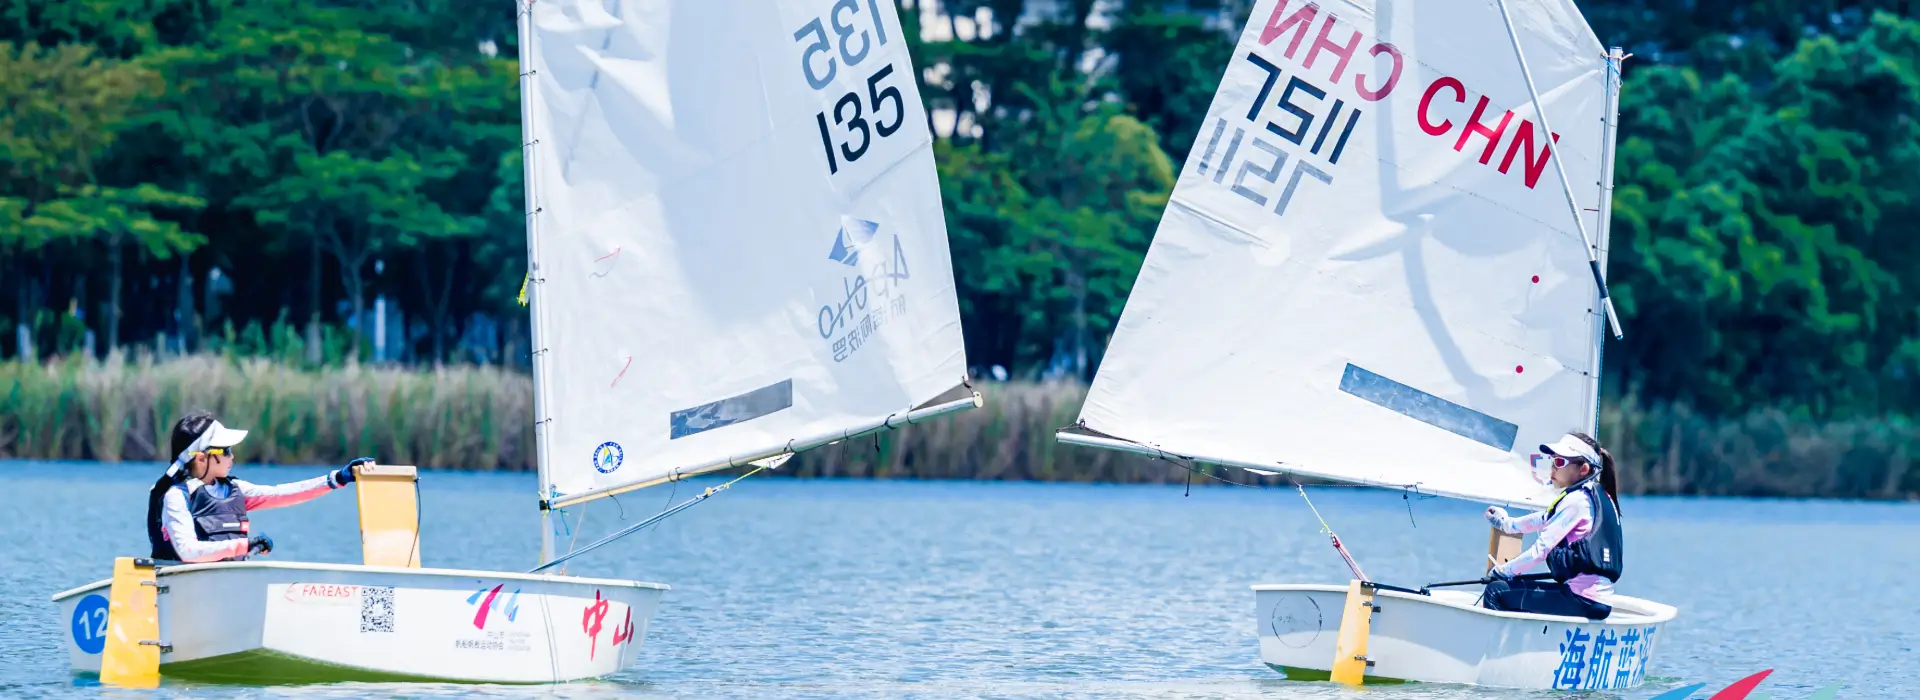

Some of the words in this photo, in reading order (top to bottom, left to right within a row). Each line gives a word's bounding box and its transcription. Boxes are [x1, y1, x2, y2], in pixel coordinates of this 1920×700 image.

[816, 63, 904, 176] 135
[1246, 51, 1362, 165] 7511
[1417, 76, 1560, 190] CHN
[78, 607, 109, 641] 12
[302, 584, 359, 598] FAREAST
[582, 589, 634, 662] 中山
